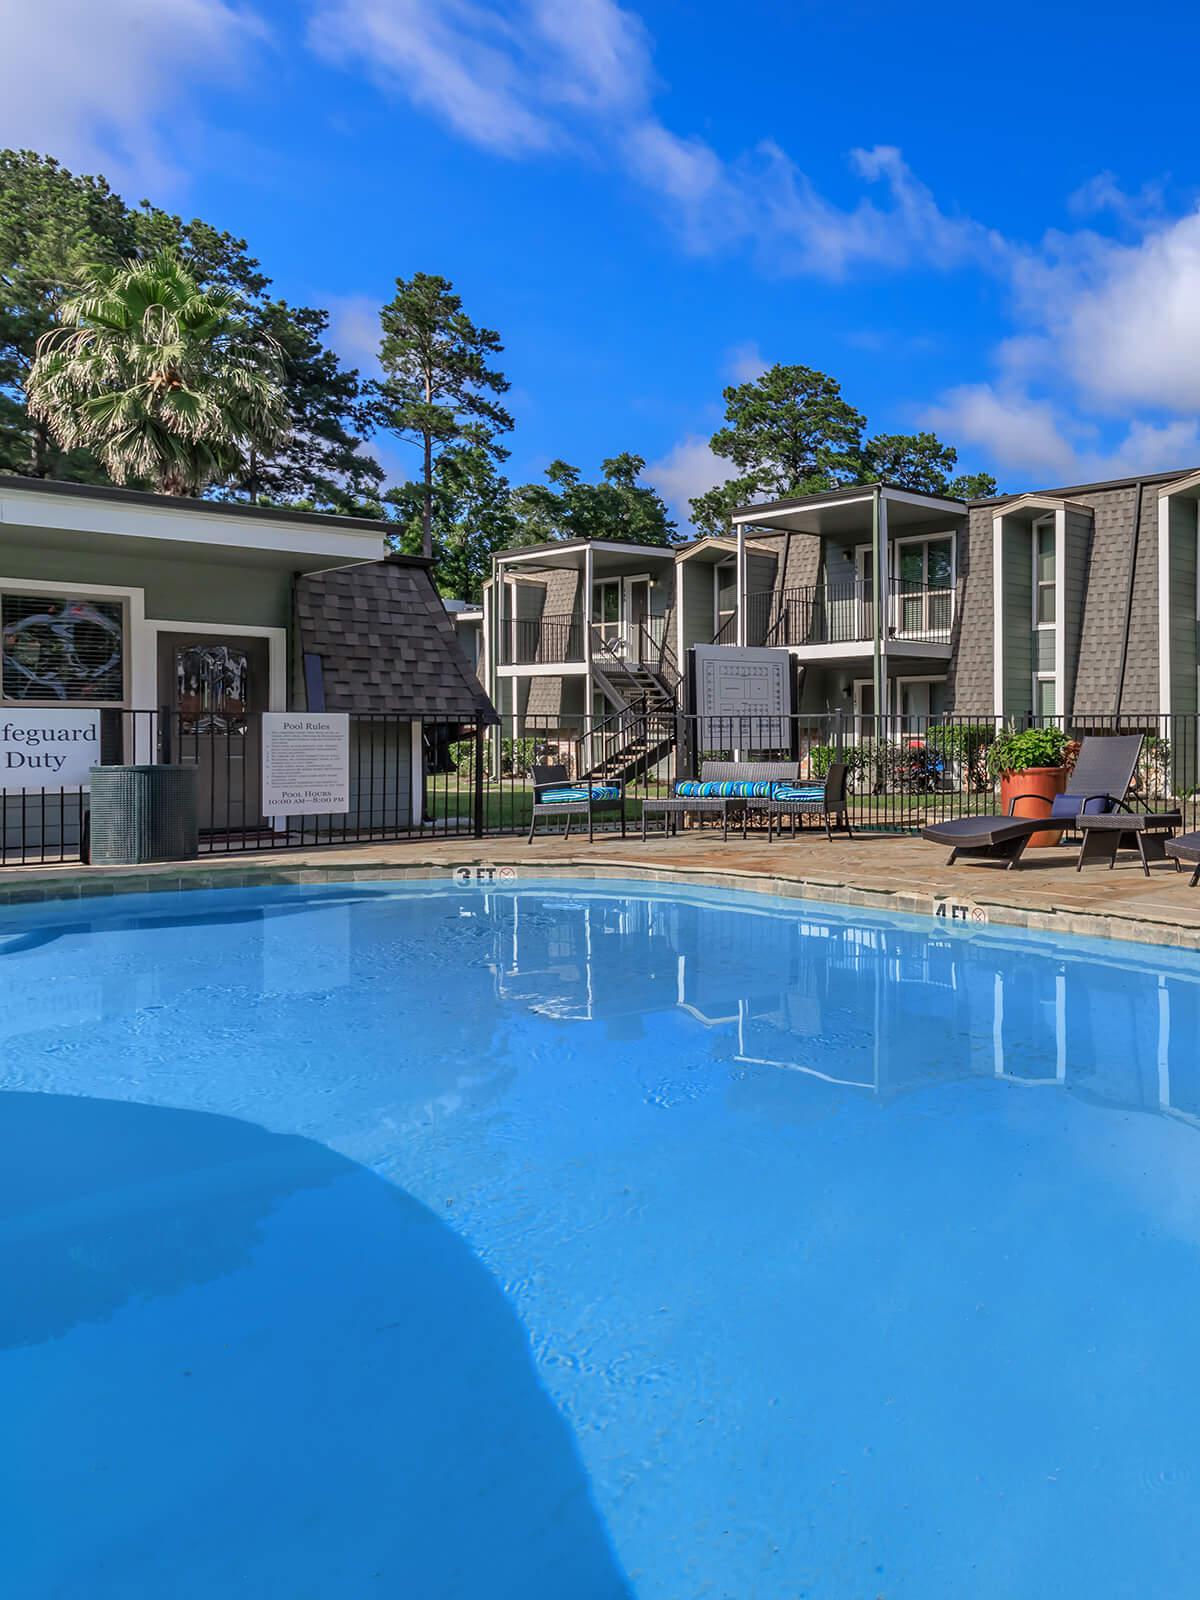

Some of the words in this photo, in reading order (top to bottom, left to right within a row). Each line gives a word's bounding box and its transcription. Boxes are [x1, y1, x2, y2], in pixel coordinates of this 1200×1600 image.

[1, 723, 97, 746] feguard
[283, 722, 303, 730] Pool
[306, 722, 330, 730] Rules
[5, 751, 67, 772] Duty
[457, 867, 471, 881] 3
[936, 903, 946, 917] 4
[952, 905, 969, 921] FT
